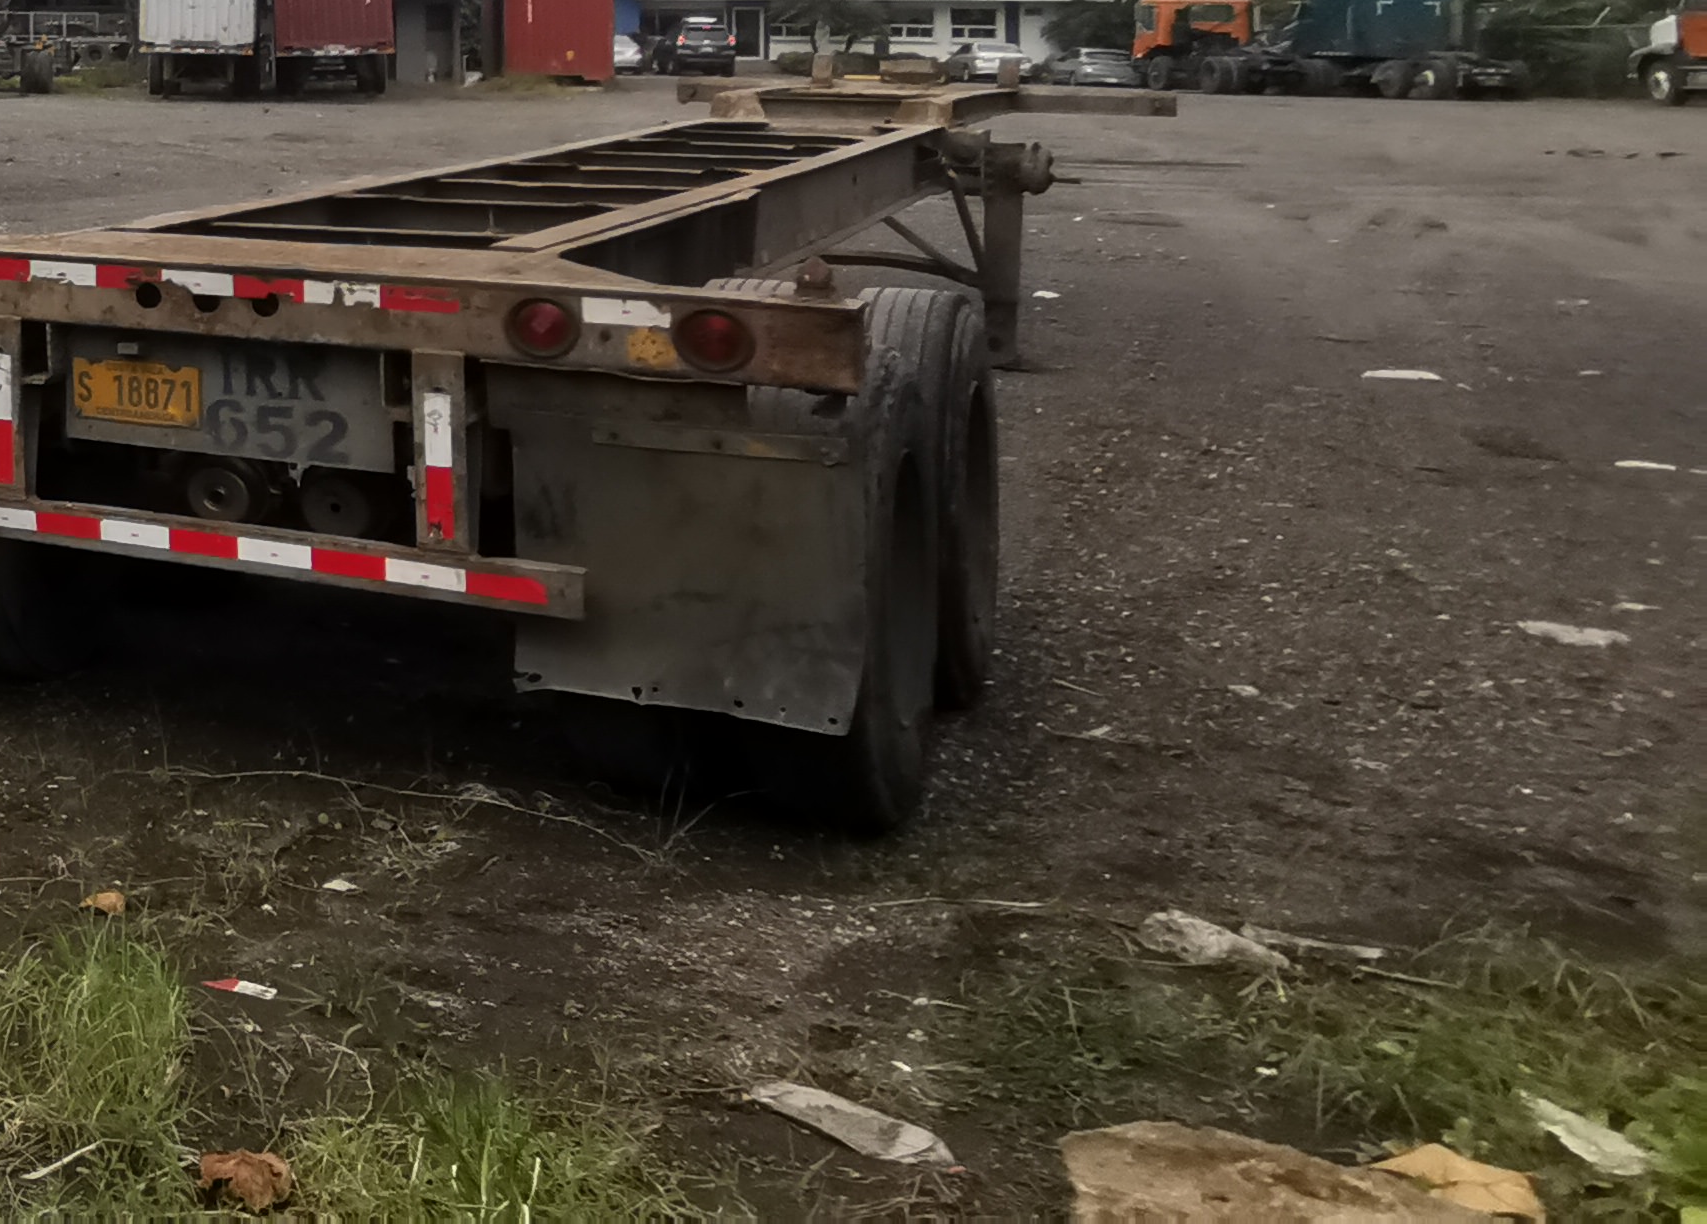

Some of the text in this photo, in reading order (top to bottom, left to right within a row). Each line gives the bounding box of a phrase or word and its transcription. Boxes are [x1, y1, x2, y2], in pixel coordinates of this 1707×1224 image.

[77, 370, 193, 413] S 18871
[205, 398, 350, 463] 652
